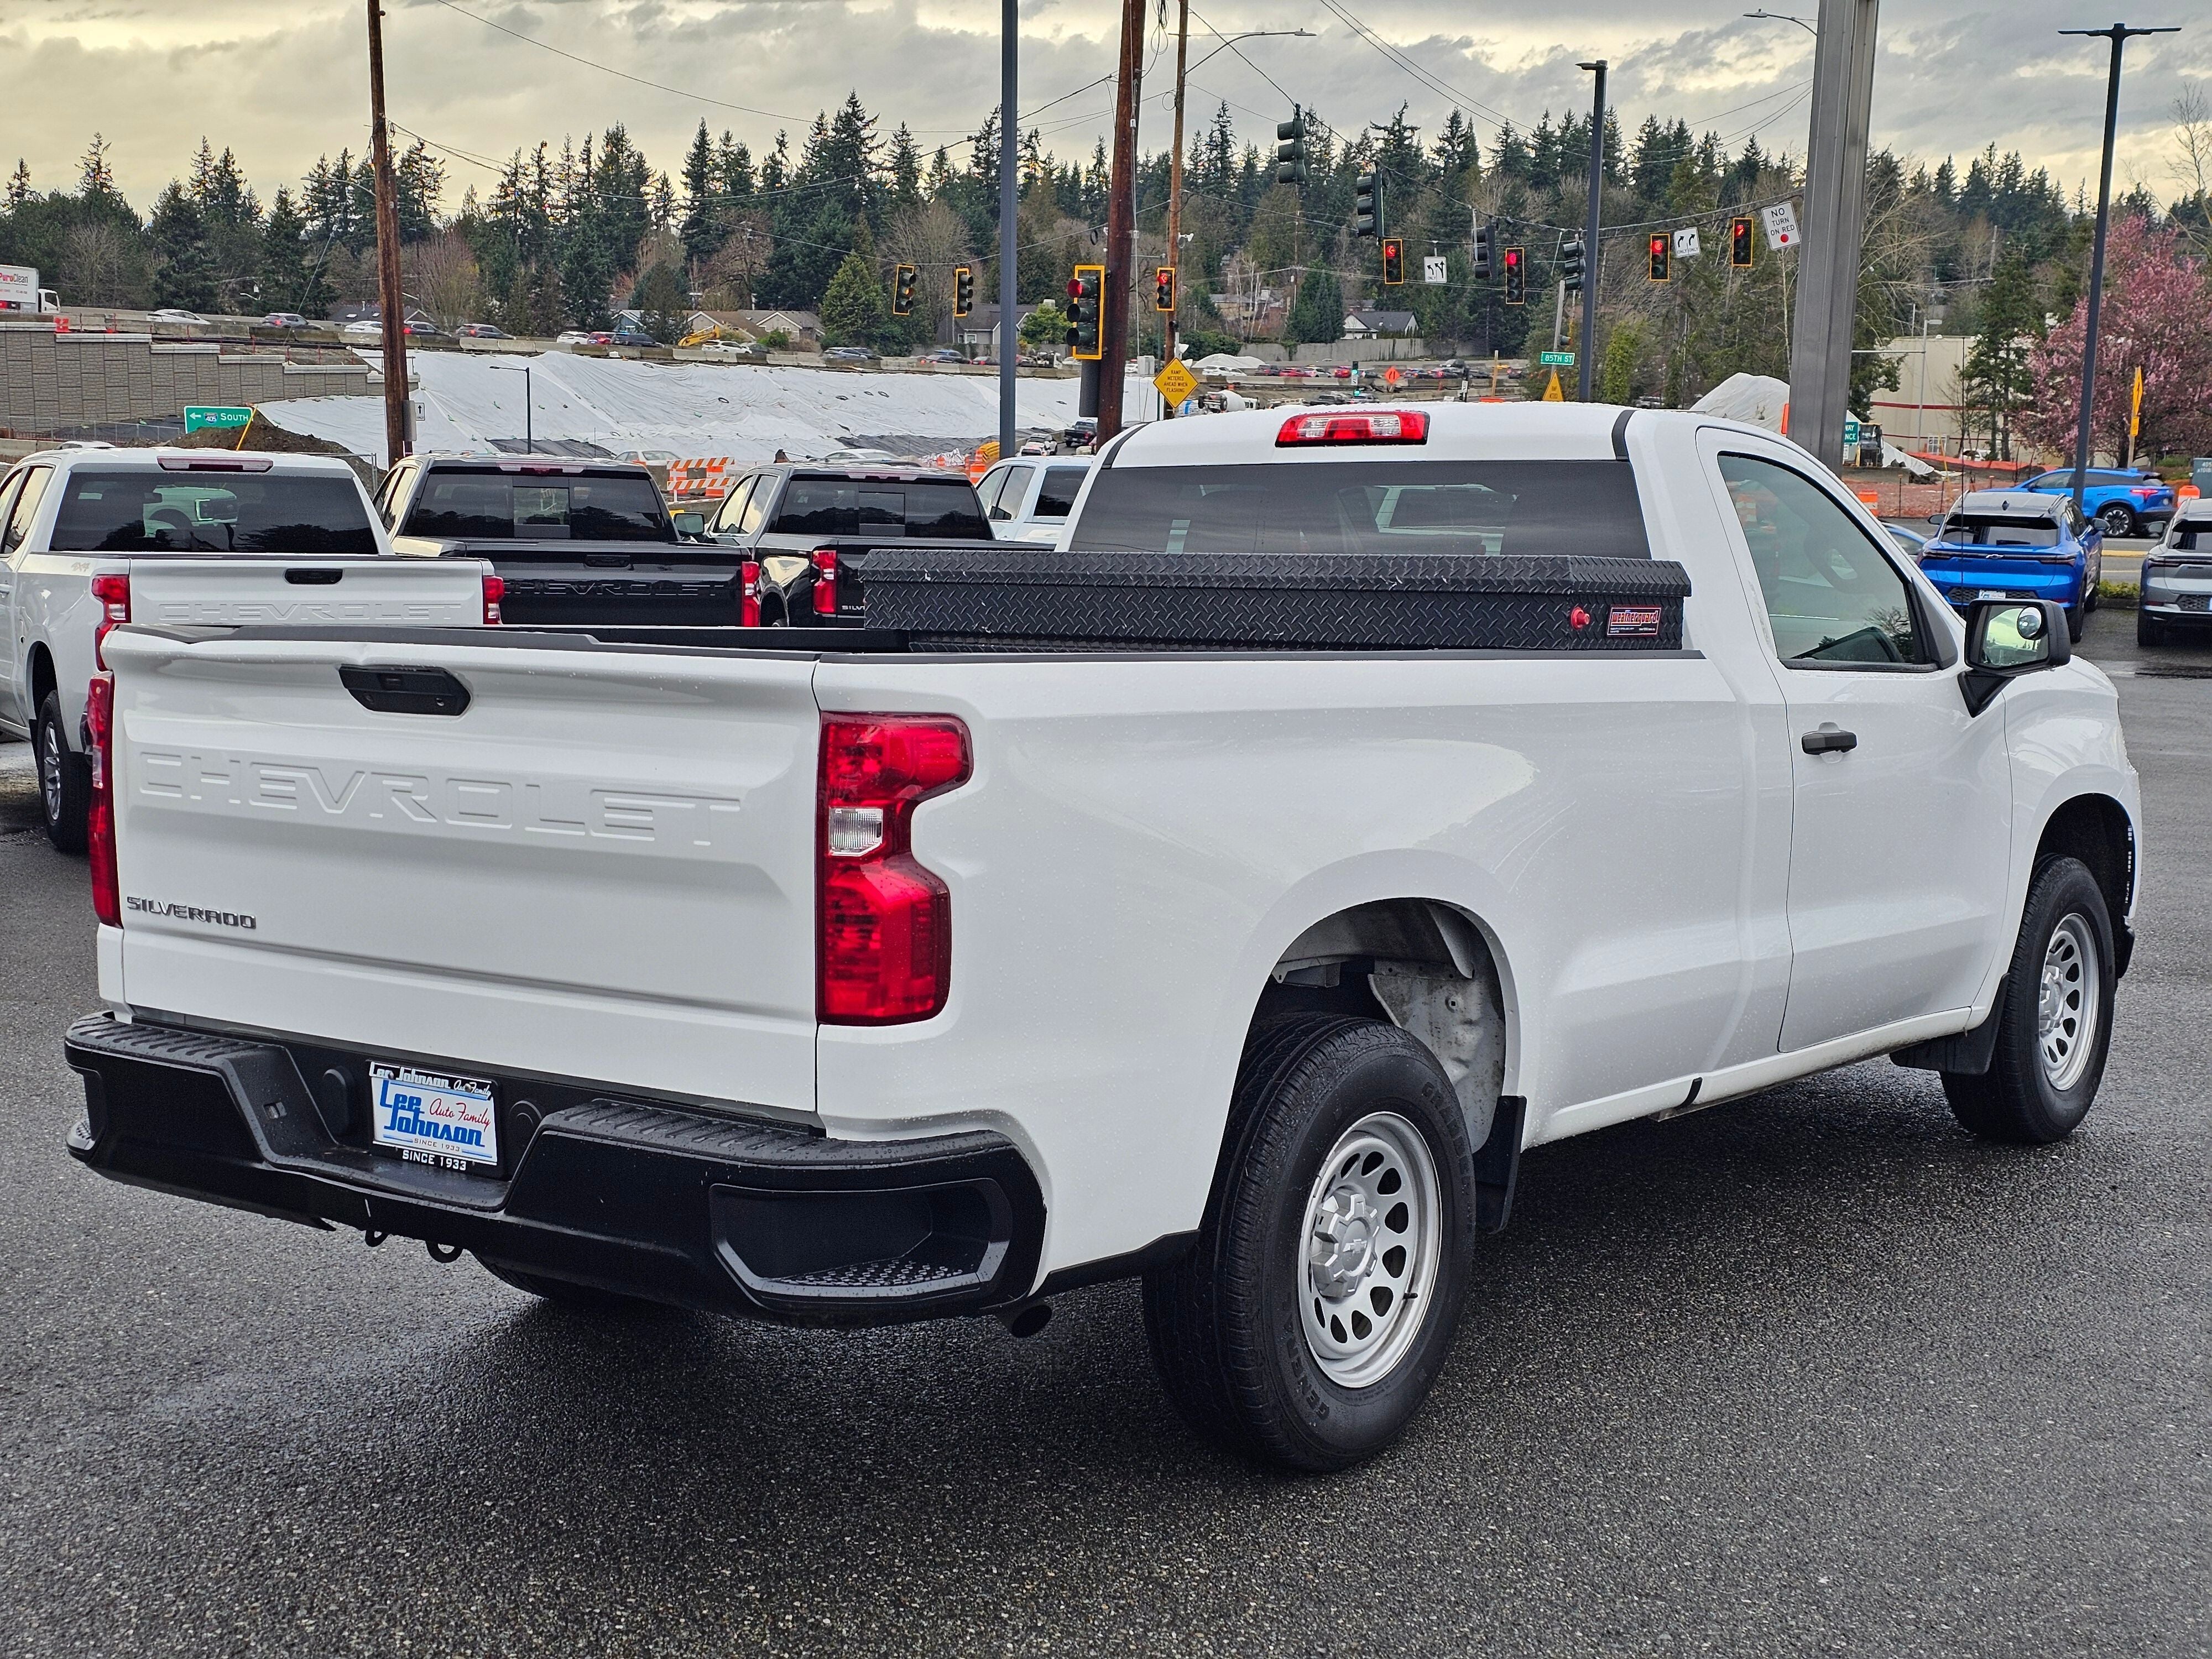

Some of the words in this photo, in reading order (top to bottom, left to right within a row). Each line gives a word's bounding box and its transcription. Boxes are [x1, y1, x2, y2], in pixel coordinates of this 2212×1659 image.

[1771, 207, 1785, 218] NO
[1772, 217, 1790, 227] TURN
[1782, 224, 1795, 232] RED
[220, 413, 249, 421] SOUTH
[504, 582, 724, 596] HEVROLET
[158, 603, 462, 620] CHEVROLET
[138, 751, 742, 846] CHEVROLET
[127, 896, 257, 930] SILVERADO
[395, 1066, 451, 1089] Johnson
[379, 1079, 425, 1114] Lee
[429, 1098, 455, 1118] Auto
[456, 1102, 491, 1132] Family
[384, 1105, 485, 1147] Johnson
[414, 1138, 437, 1147] SINCE
[441, 1143, 460, 1152] 1933
[402, 1150, 435, 1165] SINCE
[440, 1156, 467, 1171] 1933
